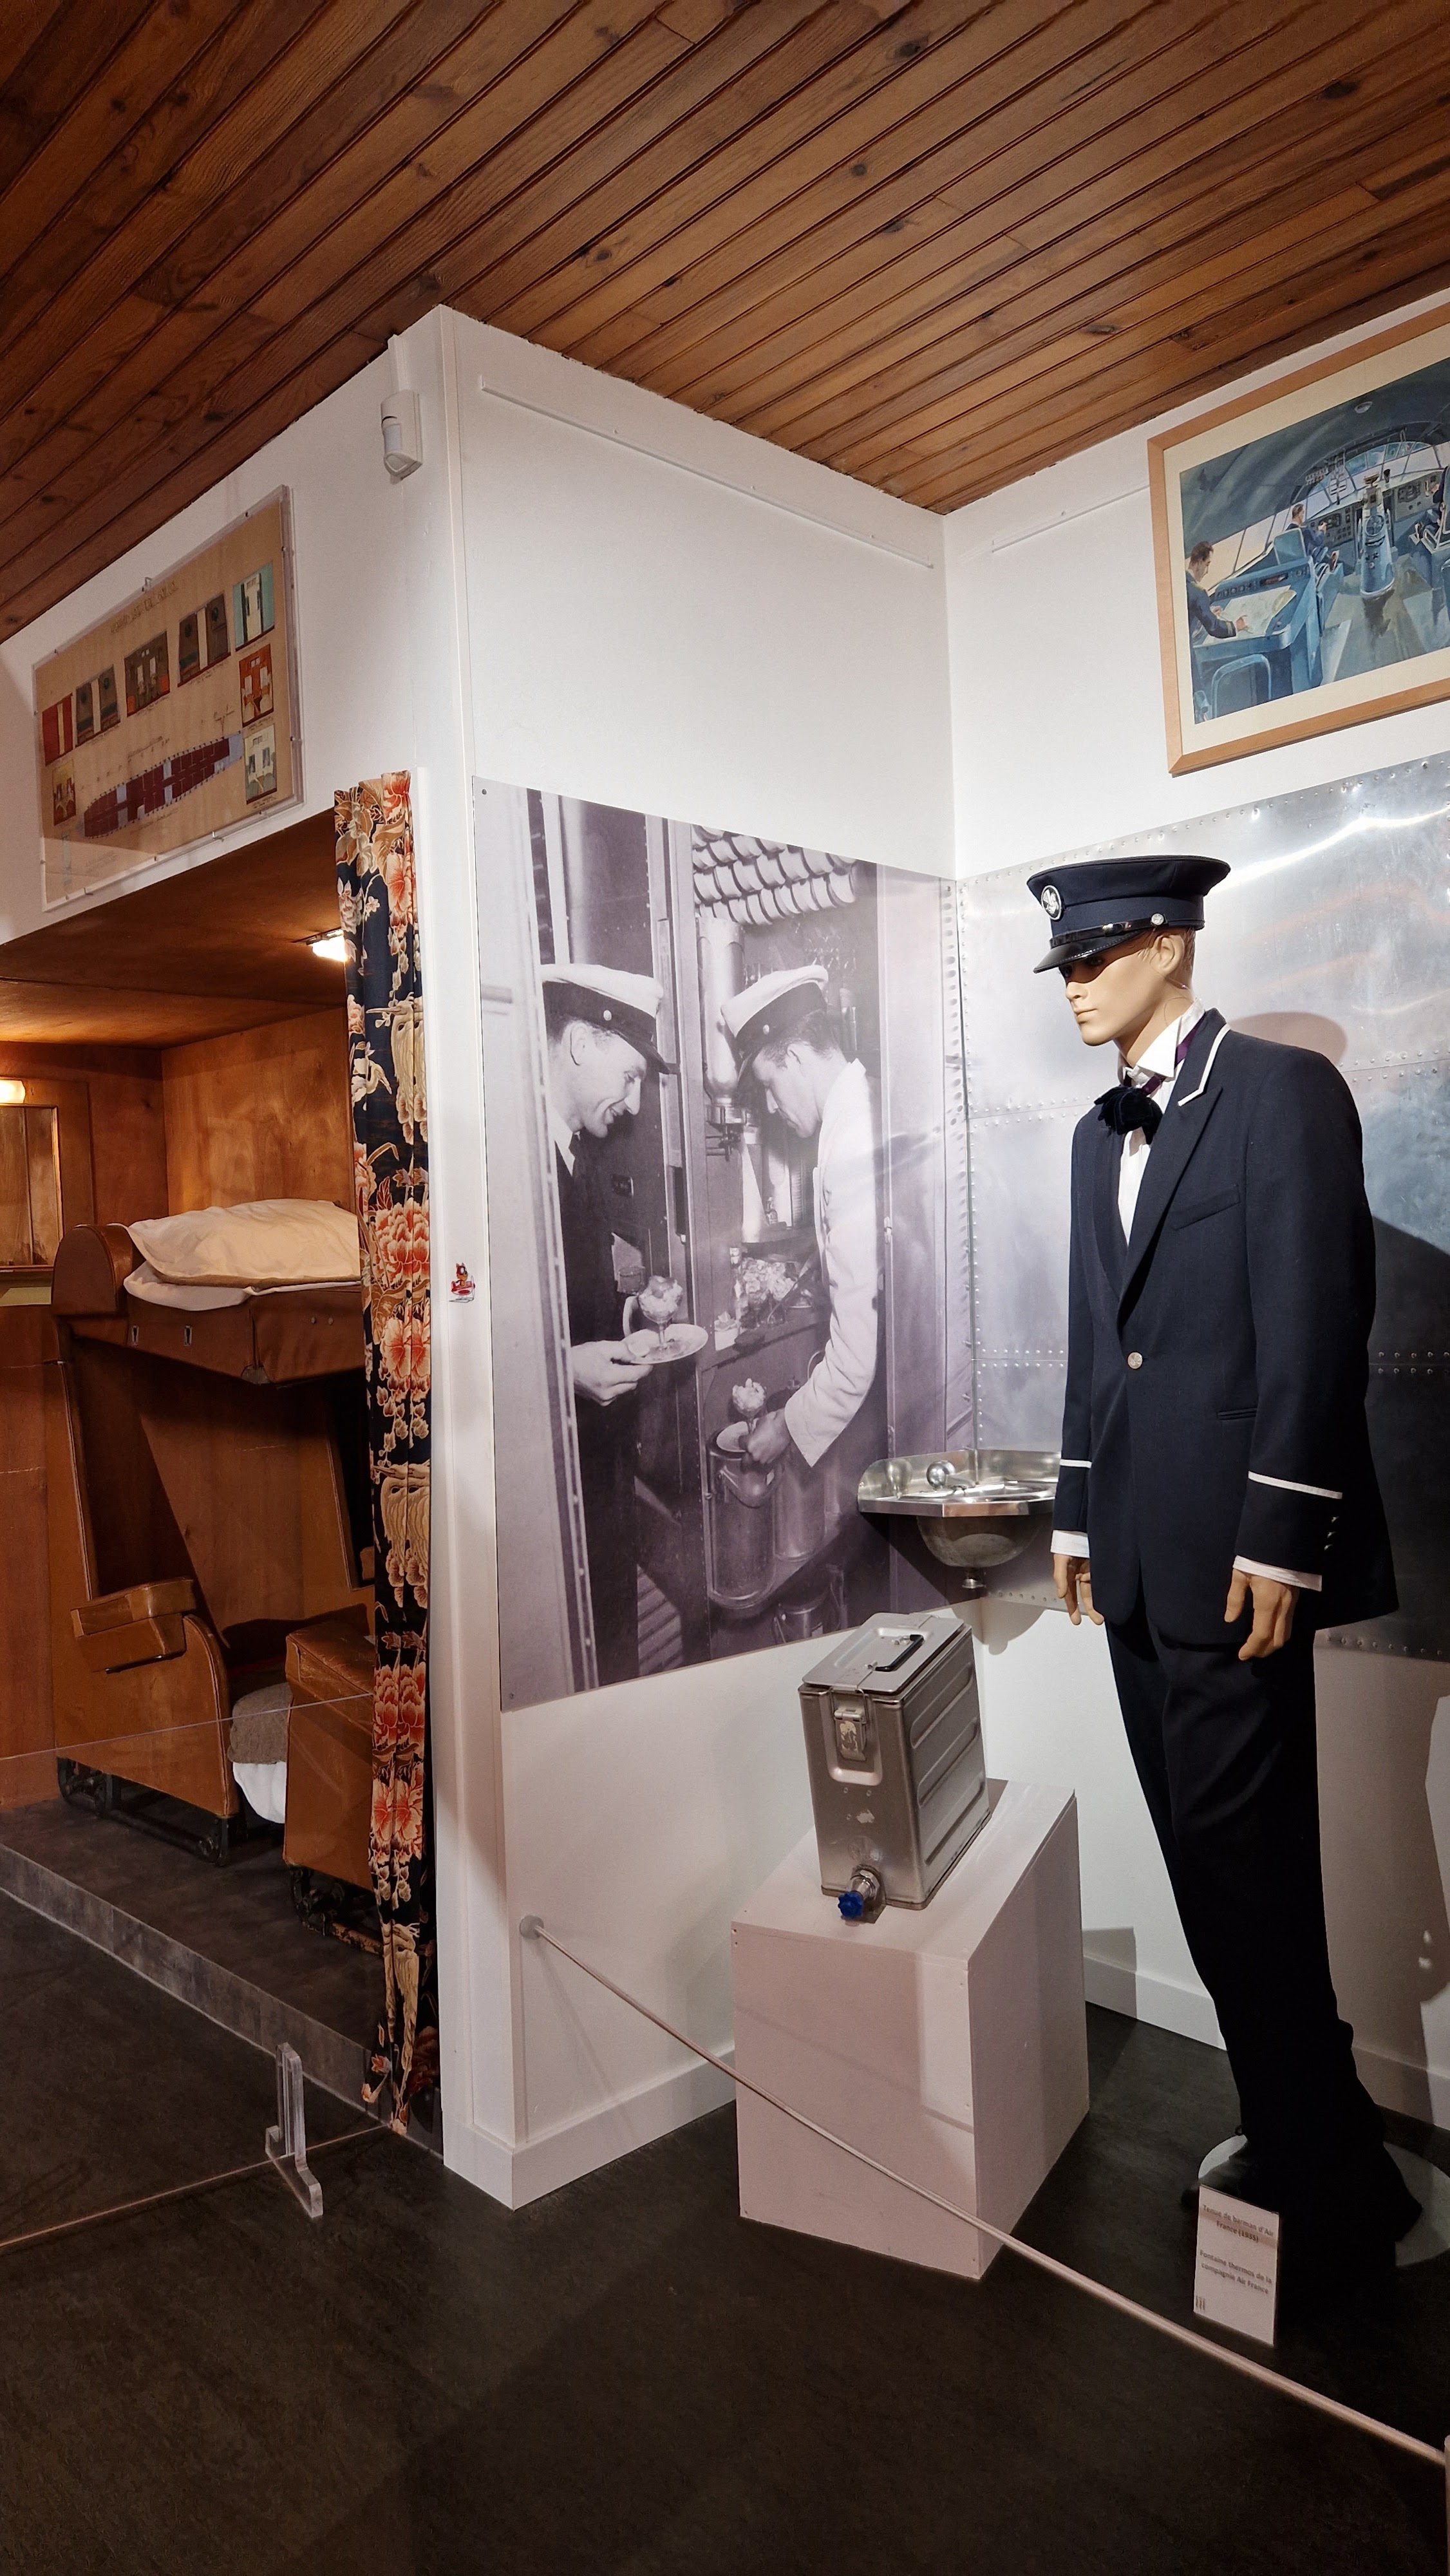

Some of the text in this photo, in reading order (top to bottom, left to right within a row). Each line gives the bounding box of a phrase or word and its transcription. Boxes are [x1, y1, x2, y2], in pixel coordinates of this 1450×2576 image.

[1216, 2220, 1237, 2234] France
[1223, 2213, 1231, 2221] de
[1200, 2249, 1272, 2284] Fontaine thermos de la
[1201, 2263, 1269, 2295] compagnie Air France
